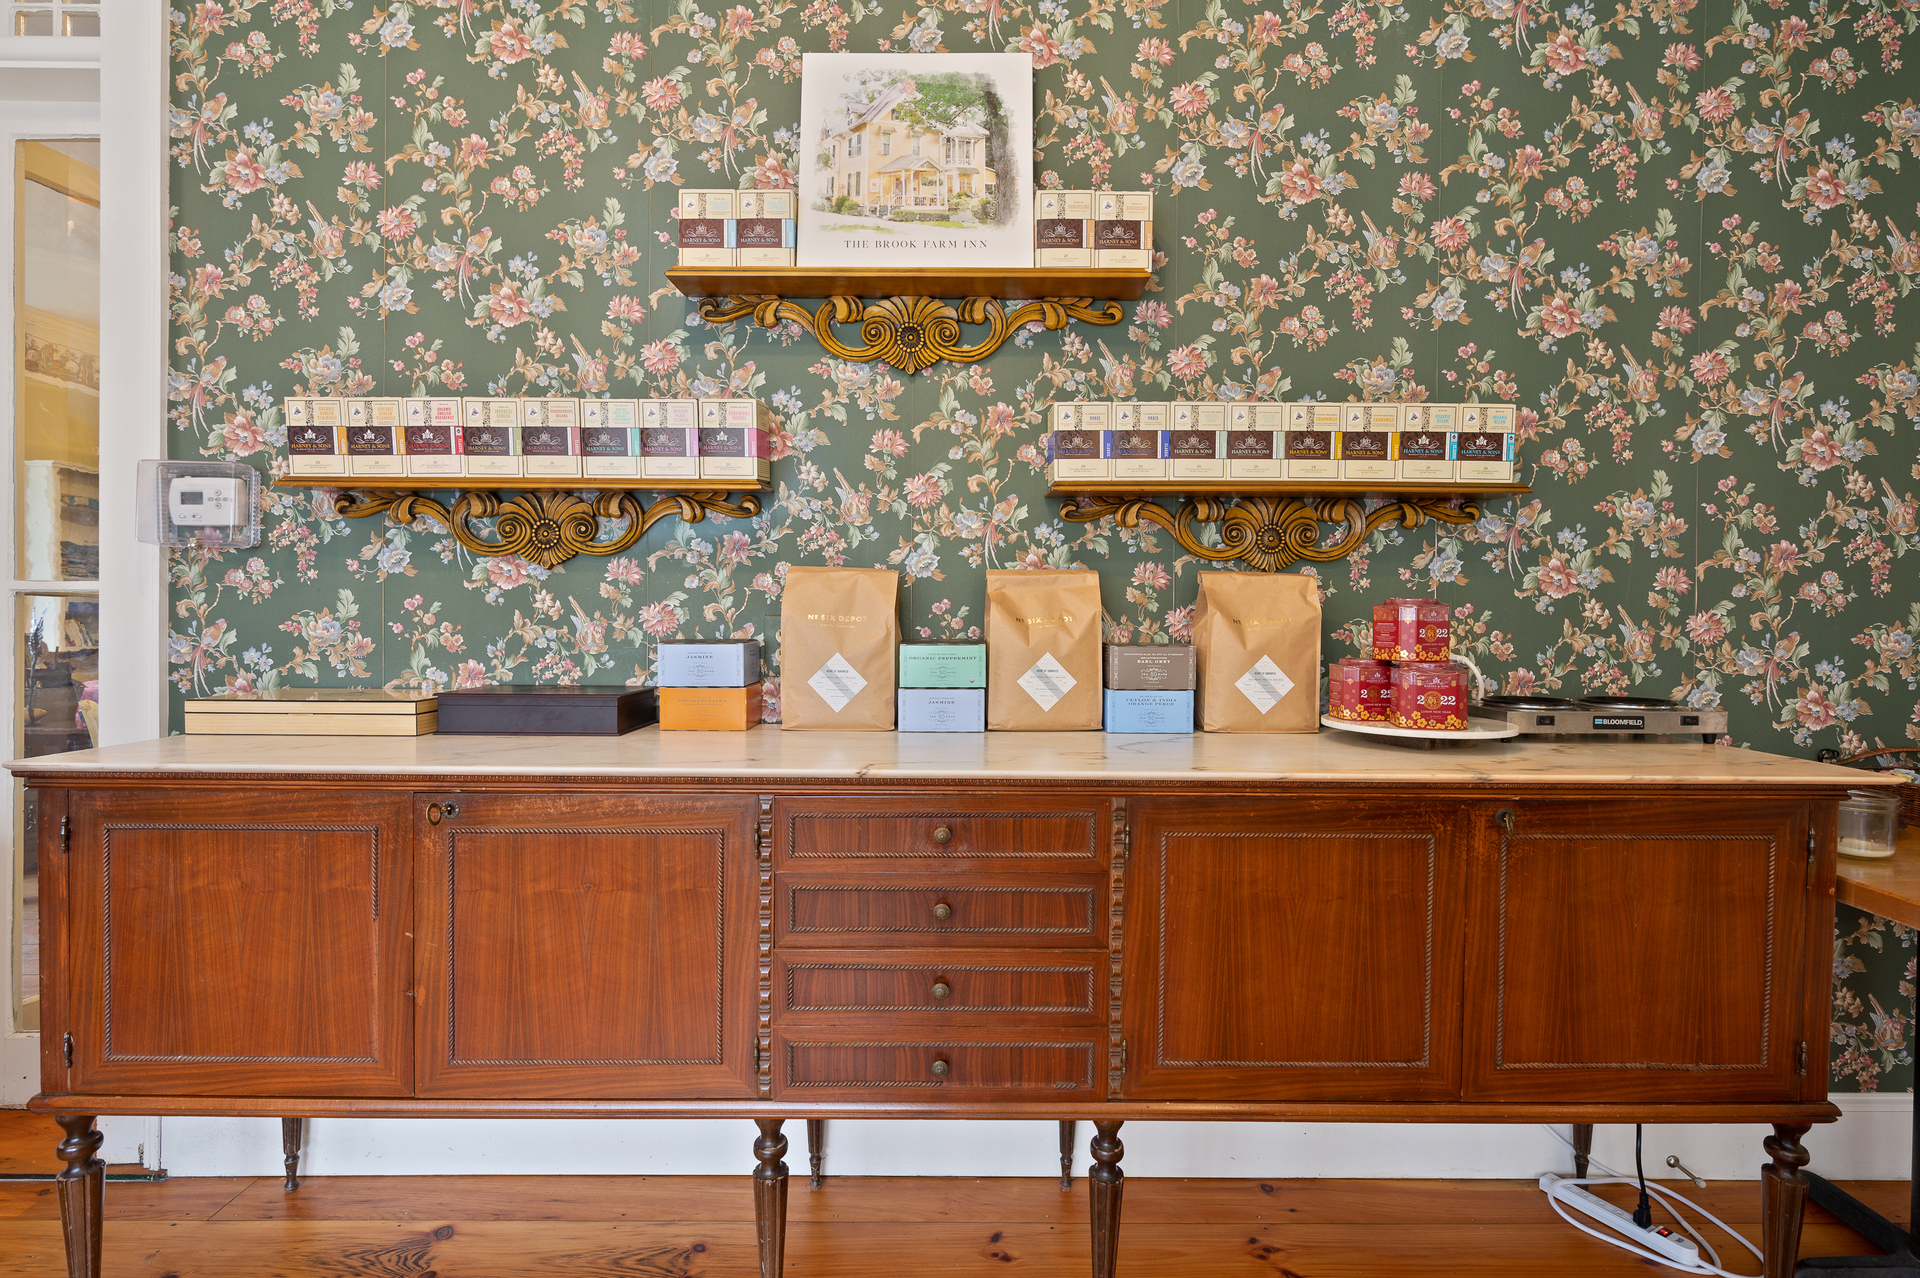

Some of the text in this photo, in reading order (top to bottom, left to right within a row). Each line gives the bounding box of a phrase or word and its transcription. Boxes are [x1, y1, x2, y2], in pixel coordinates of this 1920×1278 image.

[844, 240, 988, 248] THE BROOK FARM INN
[820, 614, 836, 622] SIX
[1602, 718, 1643, 726] BLOOMFIELD
